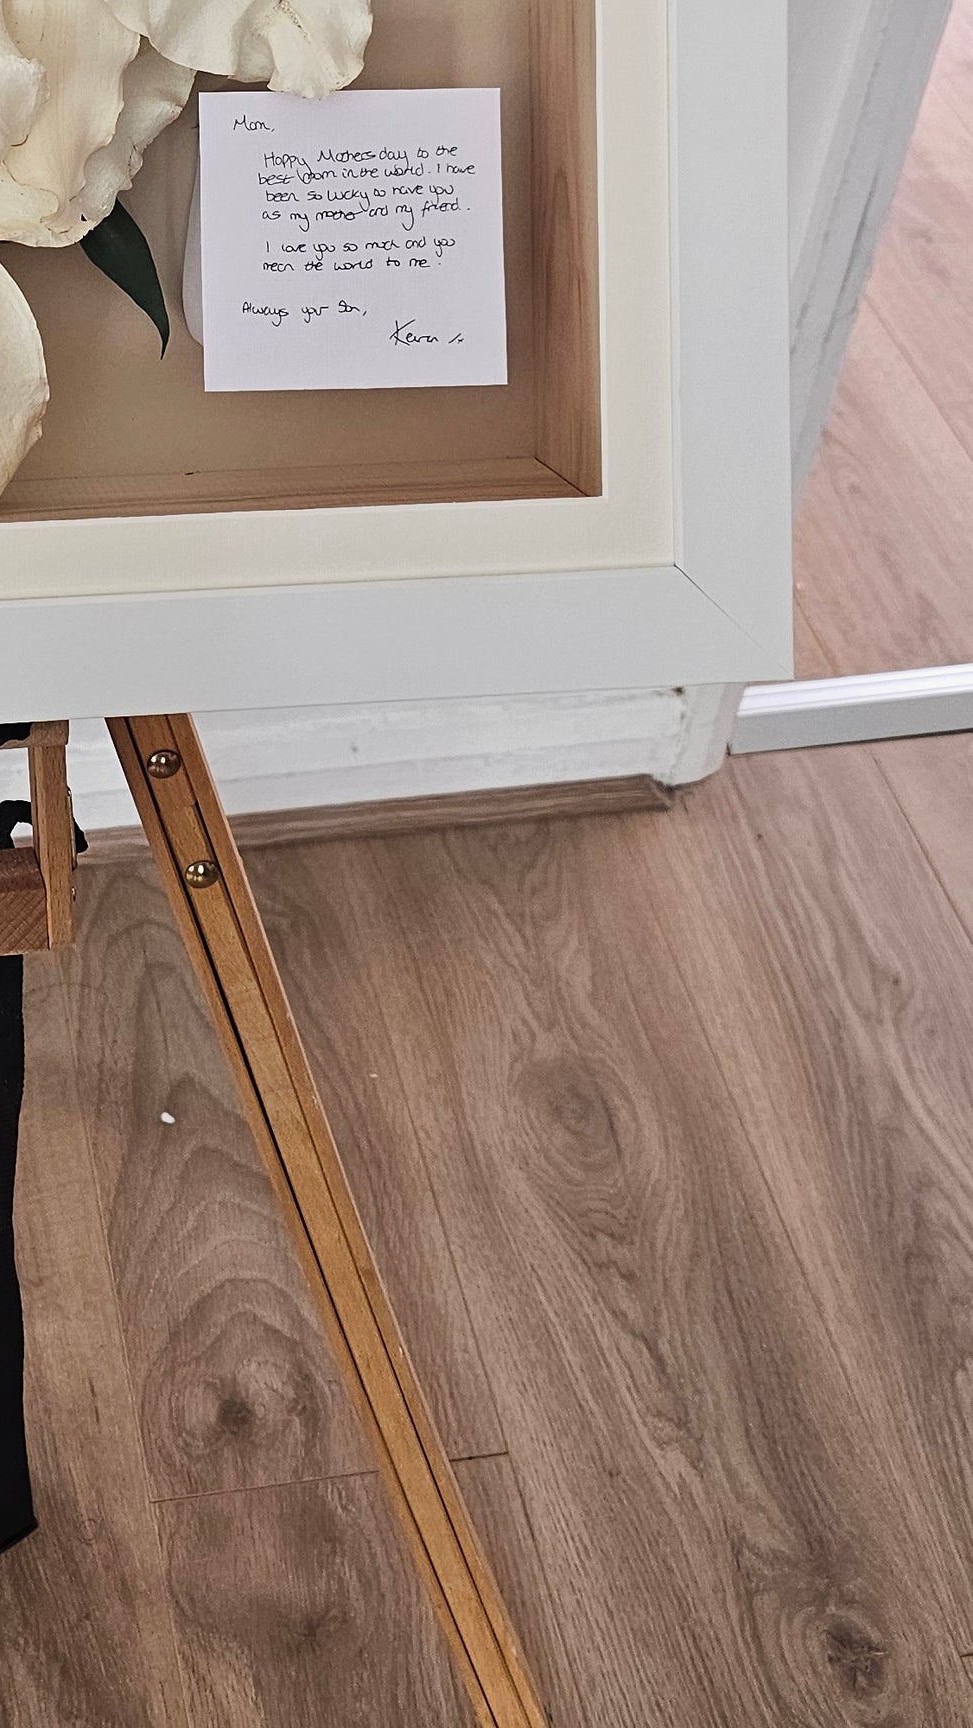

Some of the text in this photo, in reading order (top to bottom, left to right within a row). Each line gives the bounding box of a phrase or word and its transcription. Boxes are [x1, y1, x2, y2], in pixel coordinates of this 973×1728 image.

[264, 152, 312, 173] Happy
[379, 147, 409, 167] day
[417, 148, 429, 159] to
[436, 146, 458, 157] the
[258, 173, 295, 185] best
[342, 170, 357, 179] in
[360, 168, 378, 178] the
[437, 164, 441, 172] I
[446, 164, 476, 175] have
[266, 185, 454, 212] been so lucky to have you
[263, 211, 281, 220] as
[290, 211, 310, 232] my
[316, 210, 363, 220] mother
[369, 206, 388, 217] and
[396, 205, 414, 231] my
[266, 236, 455, 260] I love you so much and you
[263, 262, 294, 271] mean
[305, 261, 323, 271] the
[334, 259, 373, 270] world
[387, 257, 401, 267] to
[242, 301, 289, 327] Always
[302, 306, 329, 323] your
